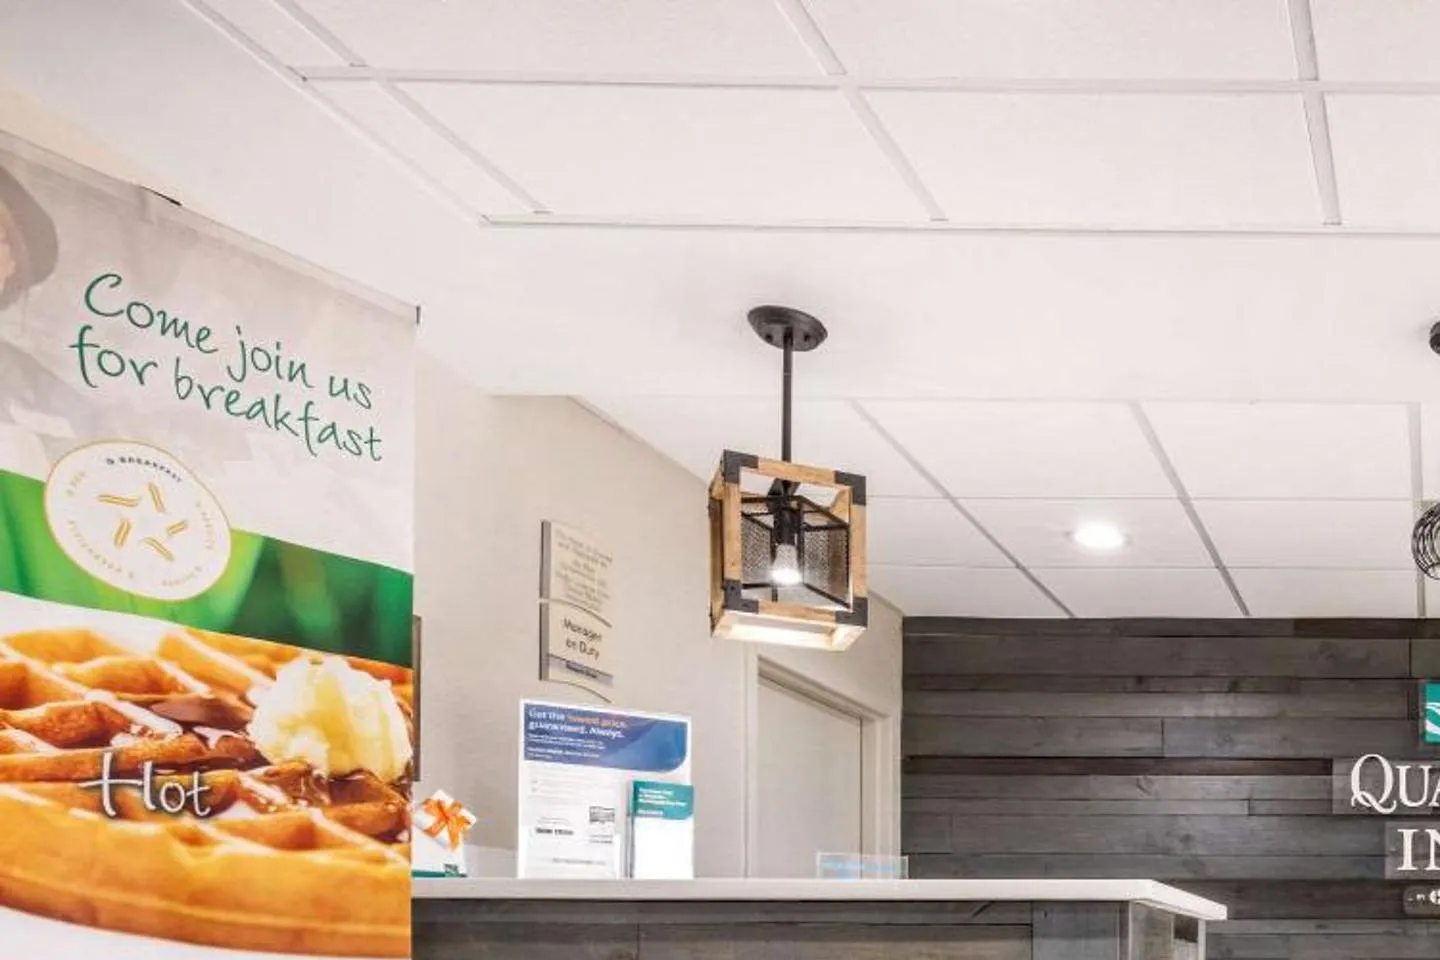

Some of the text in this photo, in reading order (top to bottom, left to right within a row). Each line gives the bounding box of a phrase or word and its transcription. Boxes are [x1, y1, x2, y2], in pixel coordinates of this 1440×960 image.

[69, 324, 382, 462] for breakfast
[84, 273, 373, 410] Come join us
[80, 751, 216, 819] Hot
